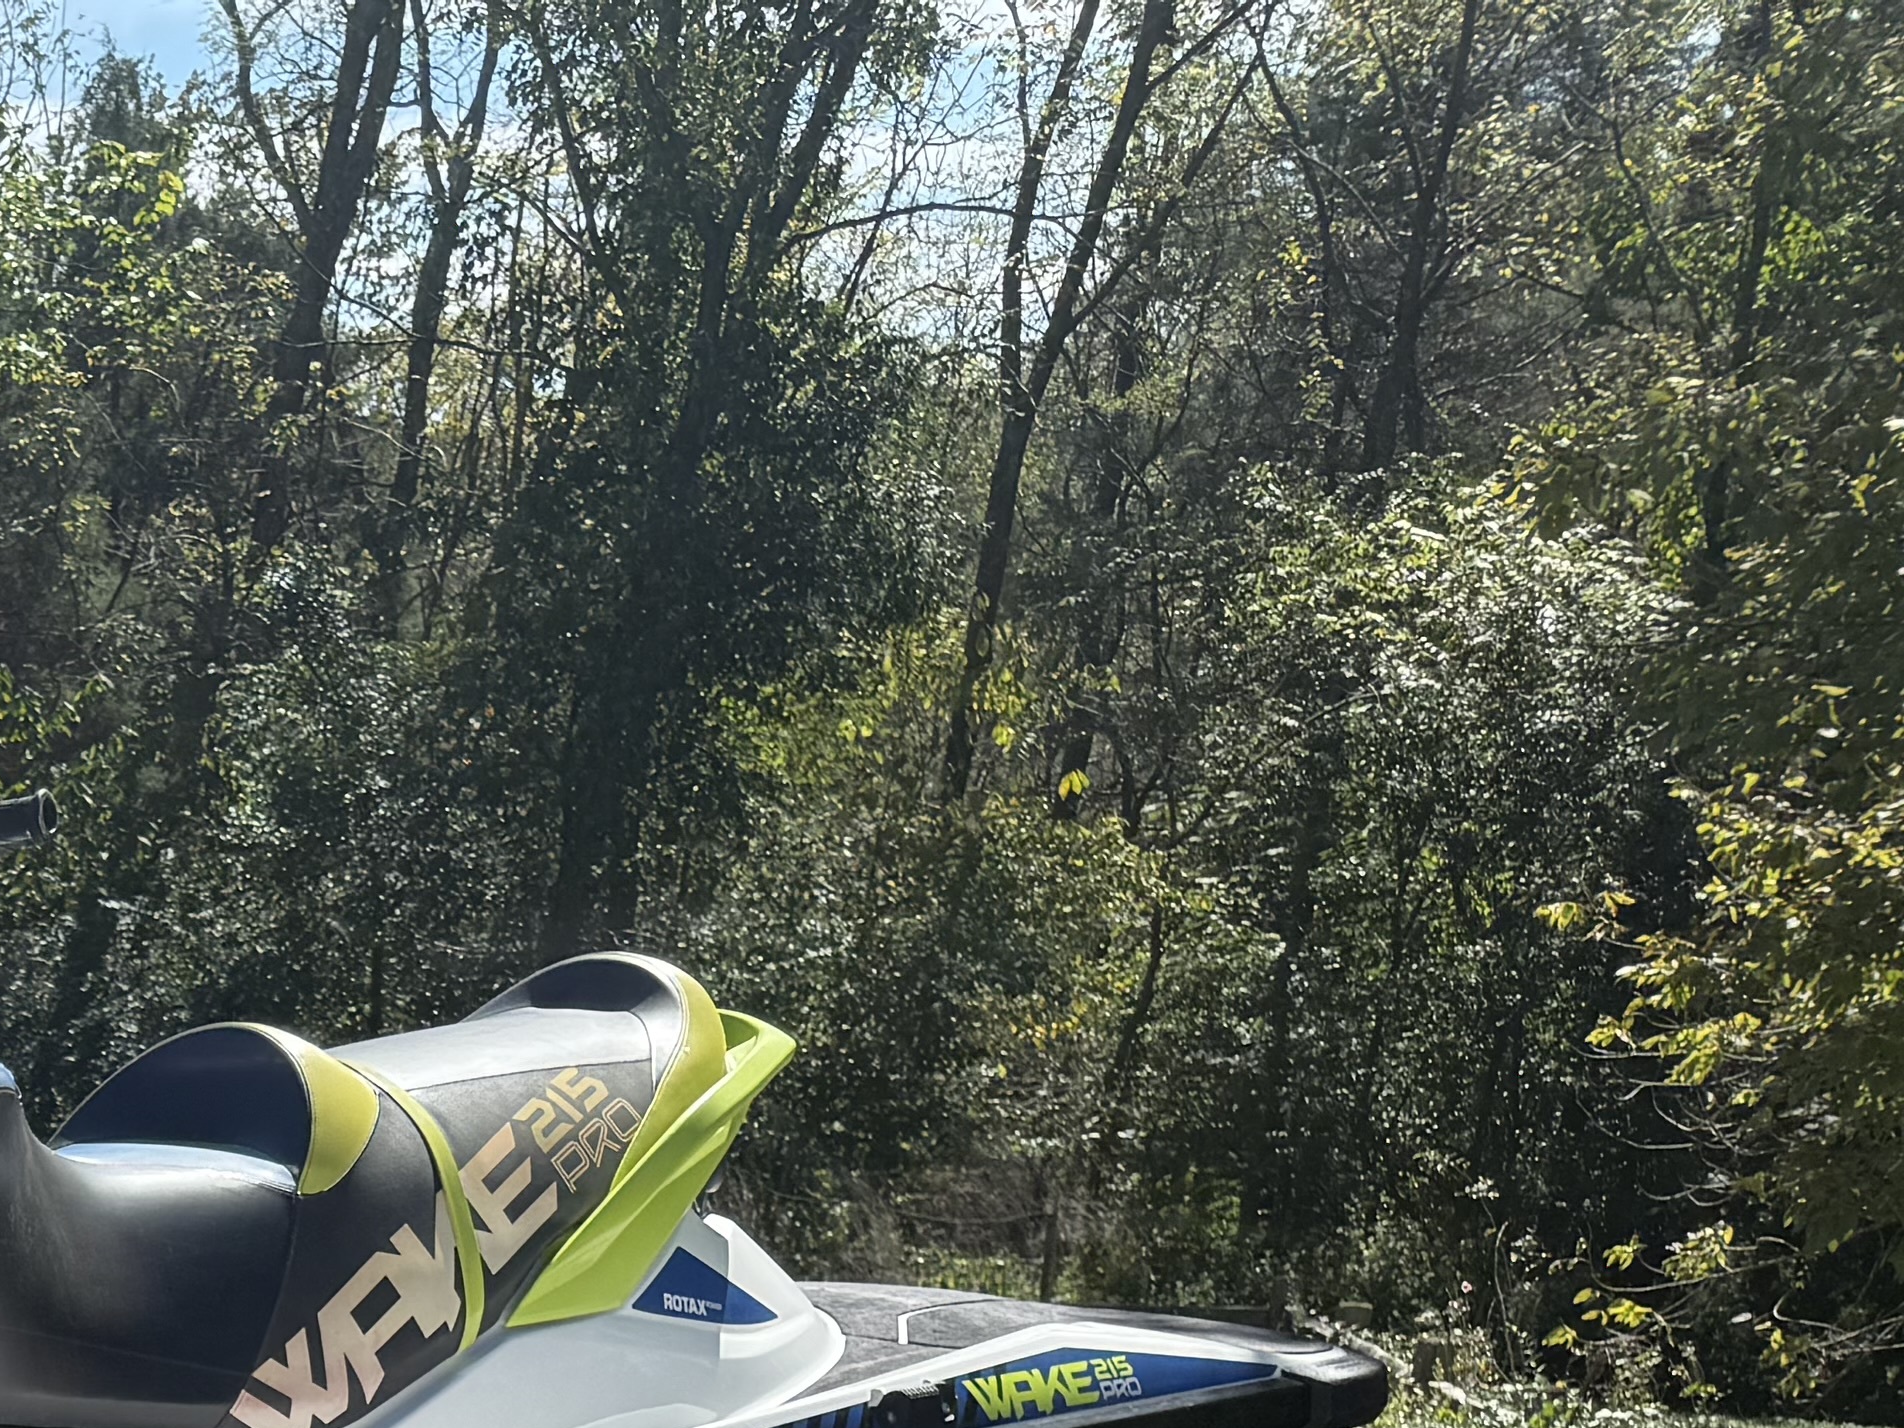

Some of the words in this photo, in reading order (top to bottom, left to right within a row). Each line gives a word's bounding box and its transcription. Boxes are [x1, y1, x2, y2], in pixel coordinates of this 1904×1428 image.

[512, 1066, 609, 1154] 215
[550, 1097, 642, 1193] PRO
[663, 1293, 707, 1316] ROTAX
[1090, 1355, 1134, 1381] 215
[1099, 1377, 1142, 1401] PRO
[961, 1360, 1100, 1421] WAKE
